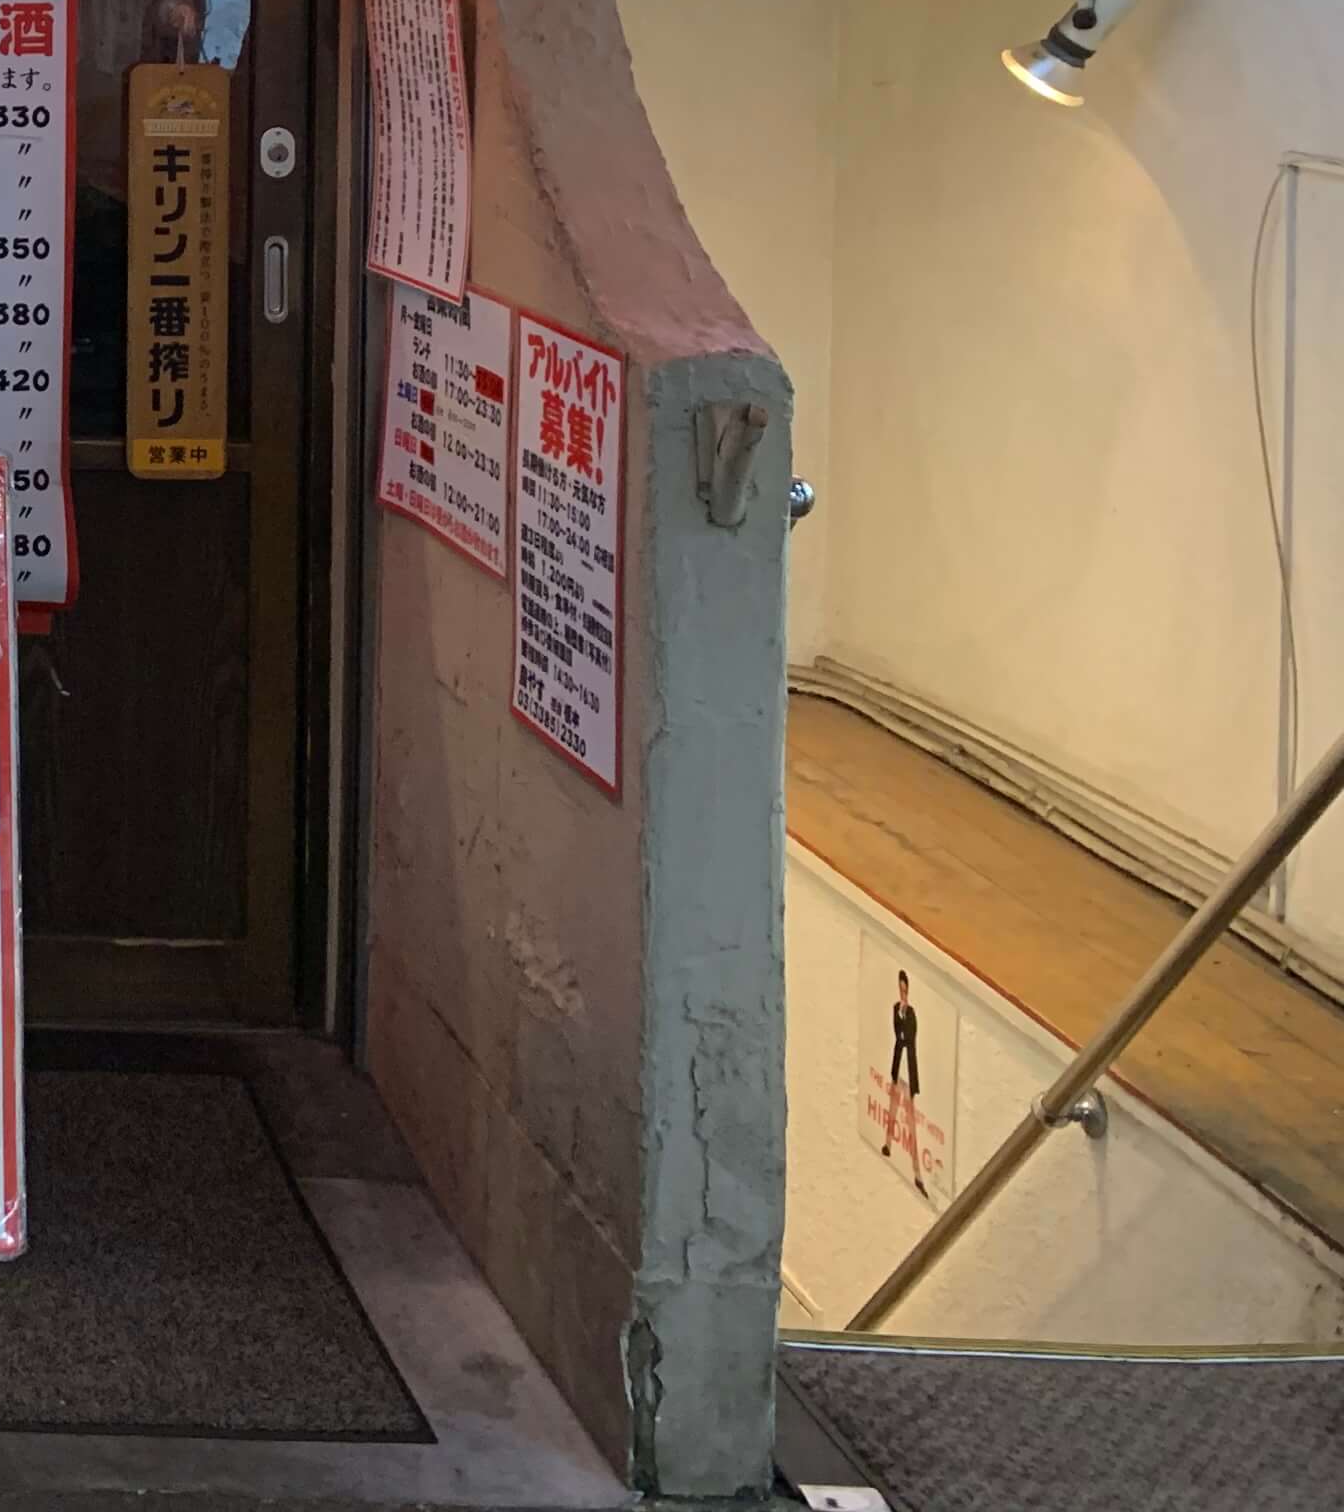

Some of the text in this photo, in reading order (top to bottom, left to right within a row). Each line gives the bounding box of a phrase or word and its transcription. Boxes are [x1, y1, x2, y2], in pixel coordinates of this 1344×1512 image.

[149, 144, 190, 427] キリン一番搾り
[528, 333, 616, 418] アルバイト
[149, 445, 207, 464] 営業中
[540, 390, 604, 486] 募集！
